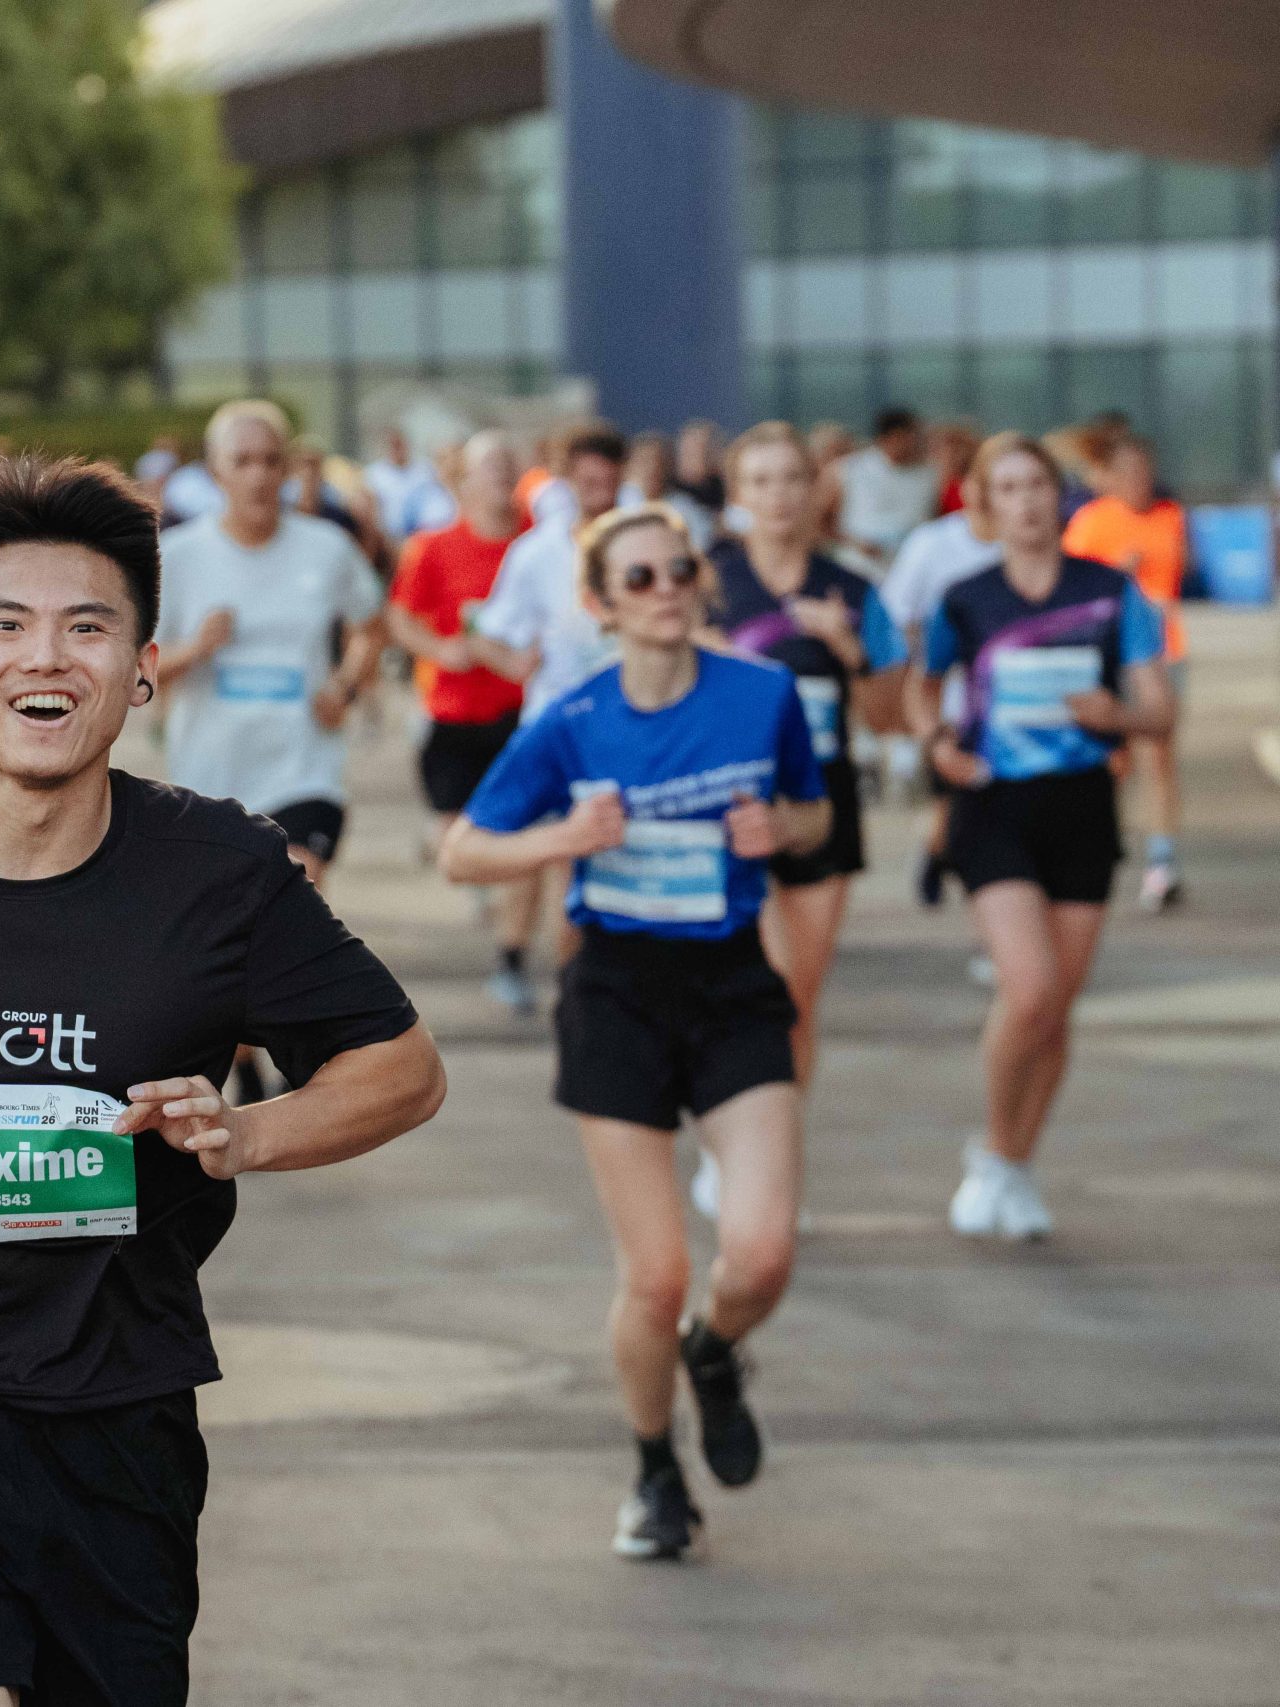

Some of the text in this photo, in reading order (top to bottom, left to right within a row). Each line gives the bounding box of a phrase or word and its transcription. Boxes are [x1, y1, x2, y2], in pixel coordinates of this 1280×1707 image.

[2, 1011, 47, 1024] GROUP
[75, 1106, 99, 1115] RUN
[41, 1115, 56, 1125] 26
[75, 1116, 99, 1125] FOR
[11, 1220, 61, 1229] BAUHAUS
